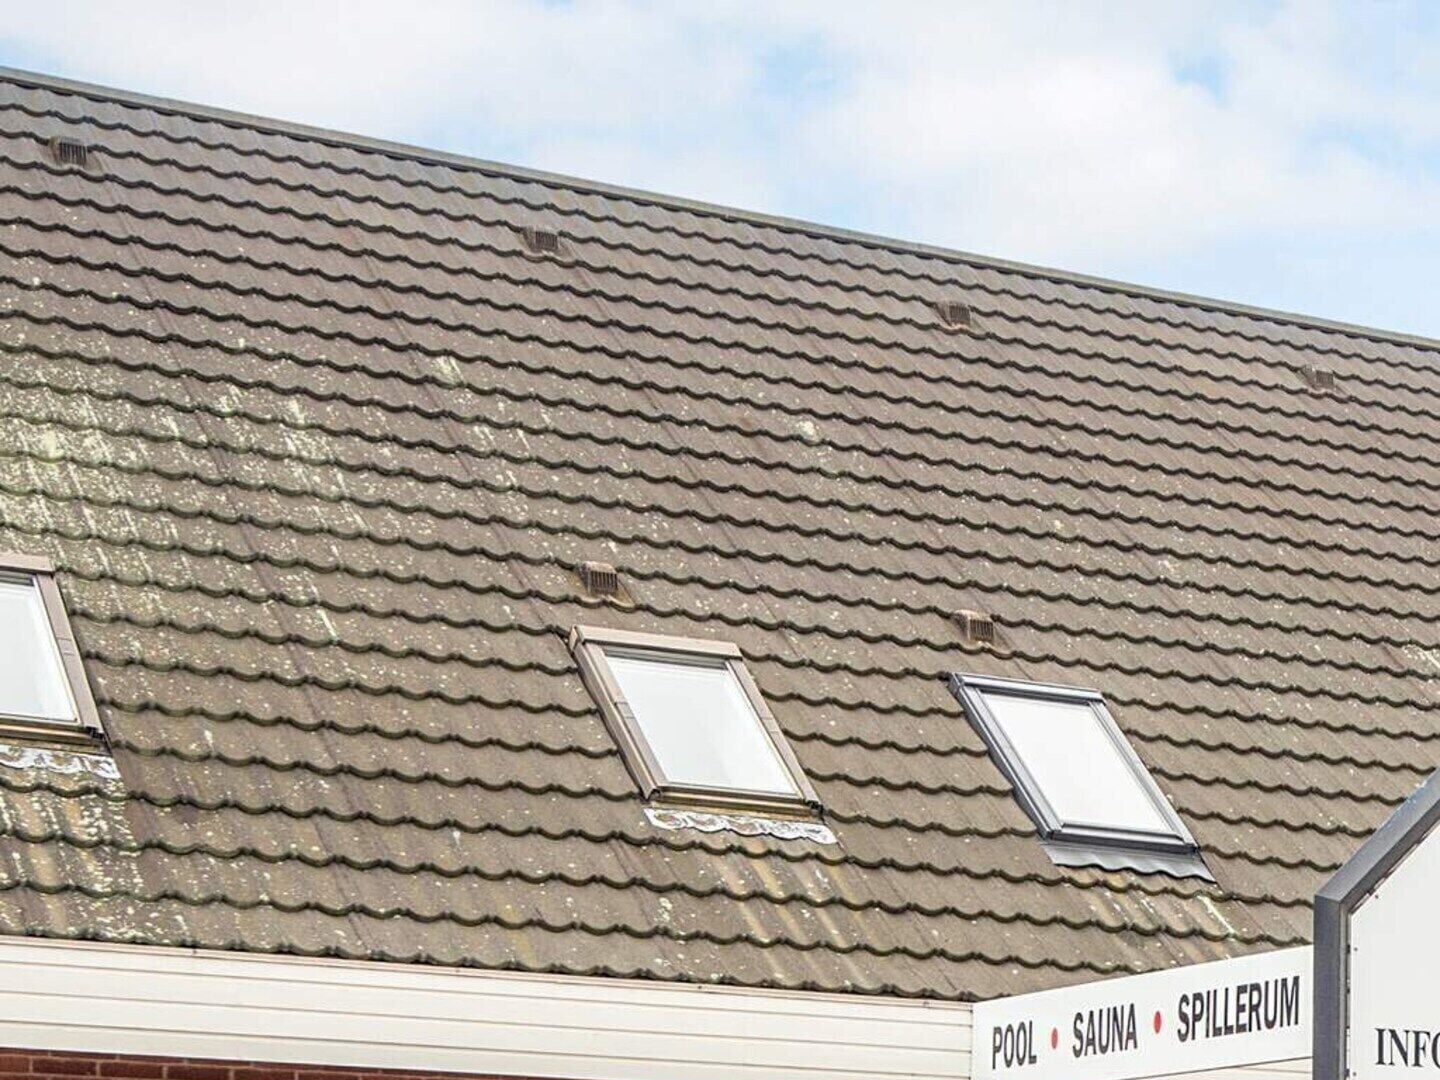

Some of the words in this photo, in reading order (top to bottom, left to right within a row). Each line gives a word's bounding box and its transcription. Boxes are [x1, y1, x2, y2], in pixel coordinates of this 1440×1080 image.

[992, 1020, 1037, 1070] POOL
[1072, 1003, 1138, 1058] SAUNA
[1177, 975, 1300, 1043] SPILLERUM
